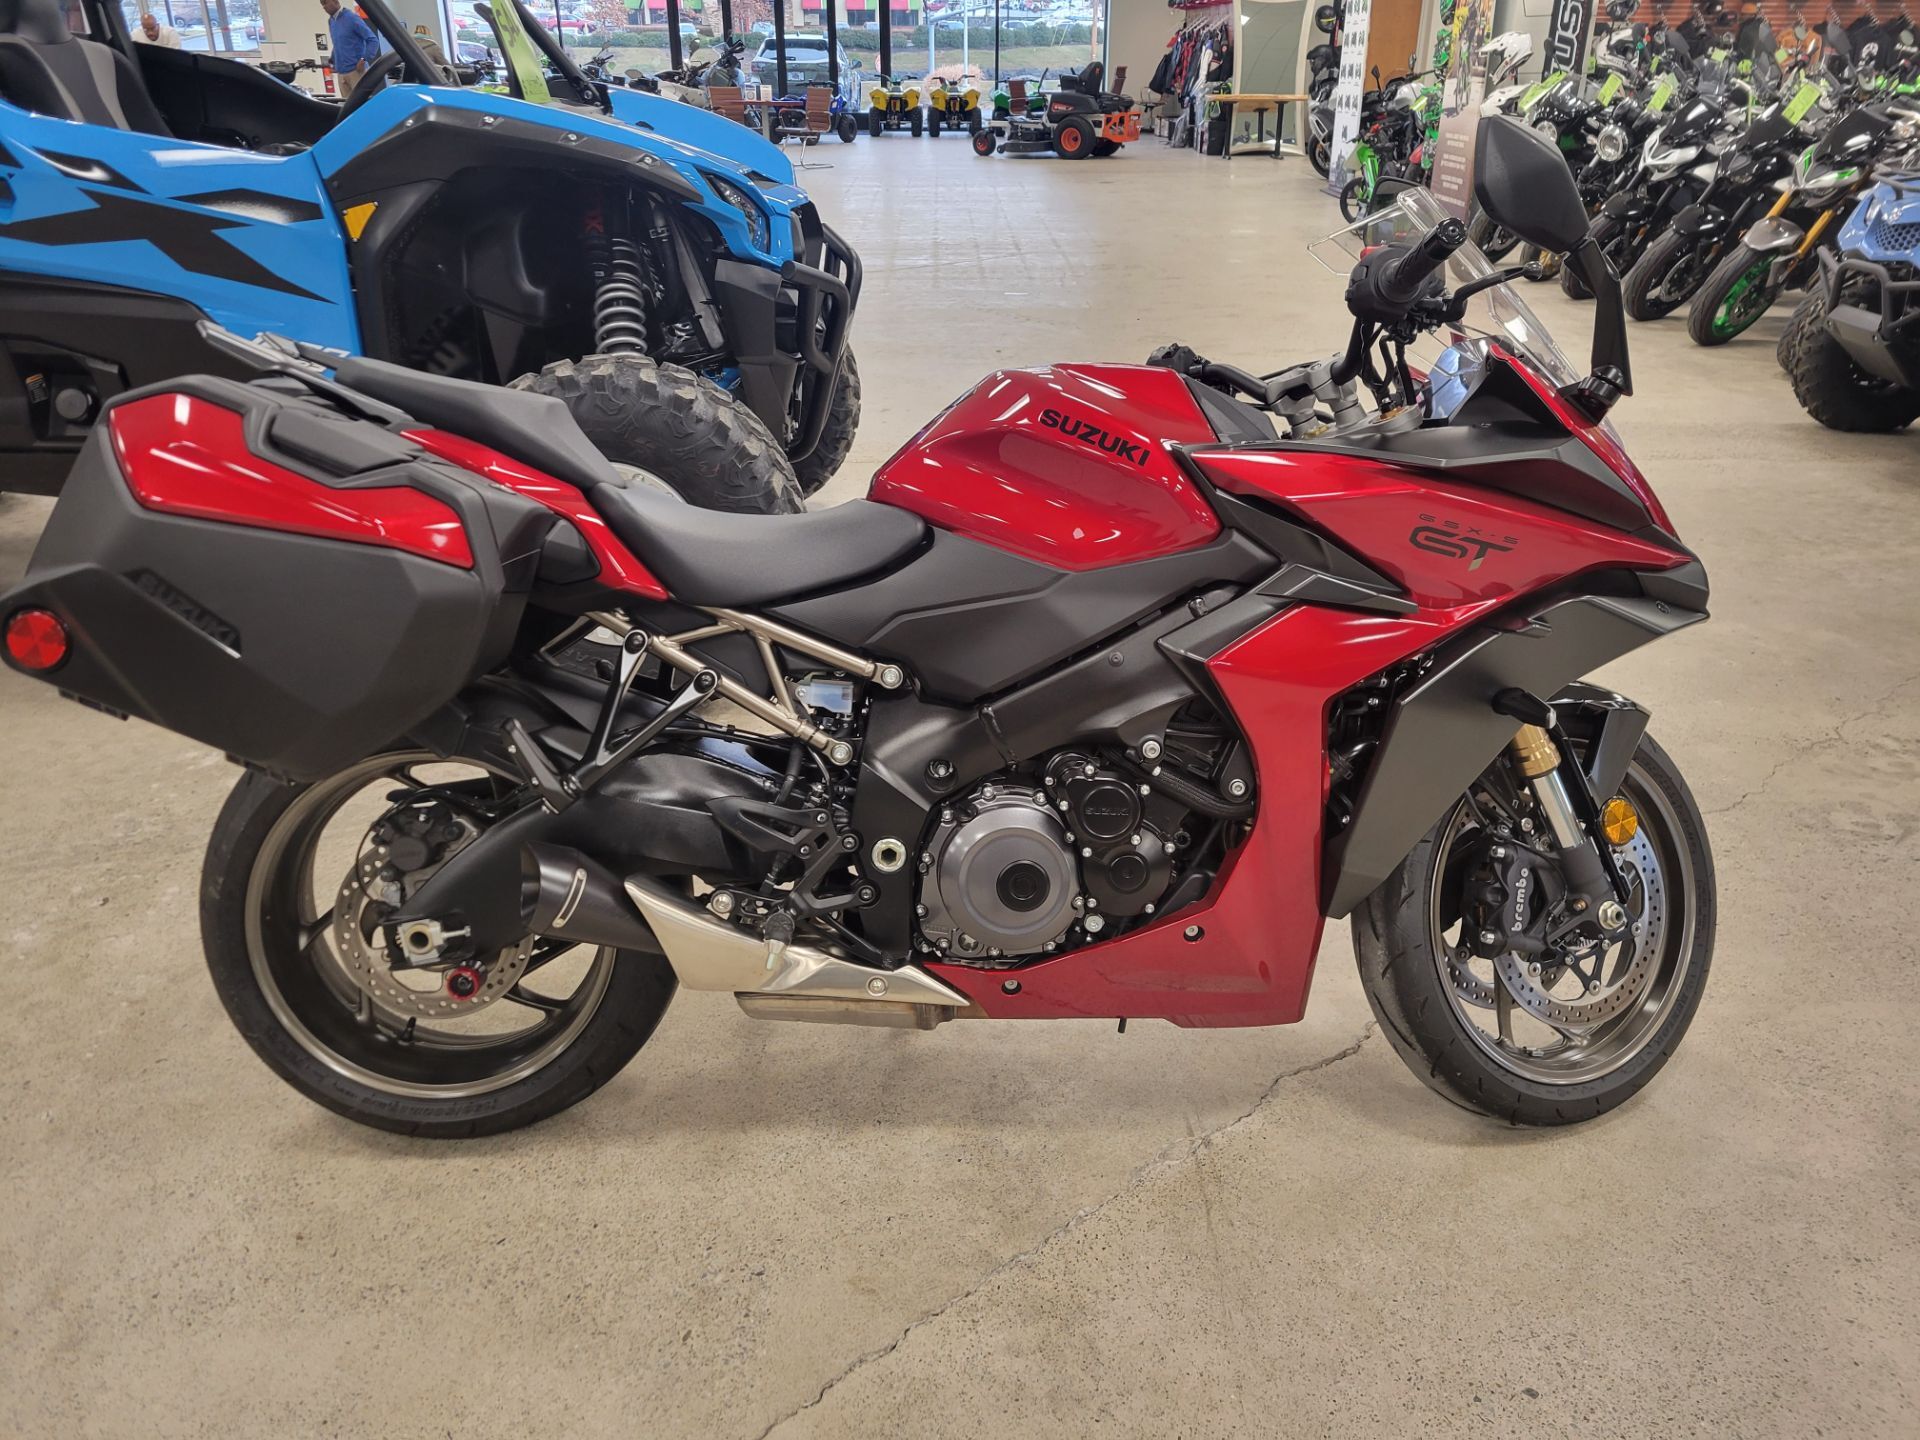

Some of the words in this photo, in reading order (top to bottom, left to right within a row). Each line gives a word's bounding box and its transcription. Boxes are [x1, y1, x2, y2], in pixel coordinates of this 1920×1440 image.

[1551, 0, 1583, 76] US
[1039, 408, 1151, 467] SUZUKI
[1409, 525, 1514, 571] GT
[1419, 512, 1519, 545] GSX-S
[136, 571, 238, 648] SUZUKI
[1510, 867, 1529, 932] brembo
